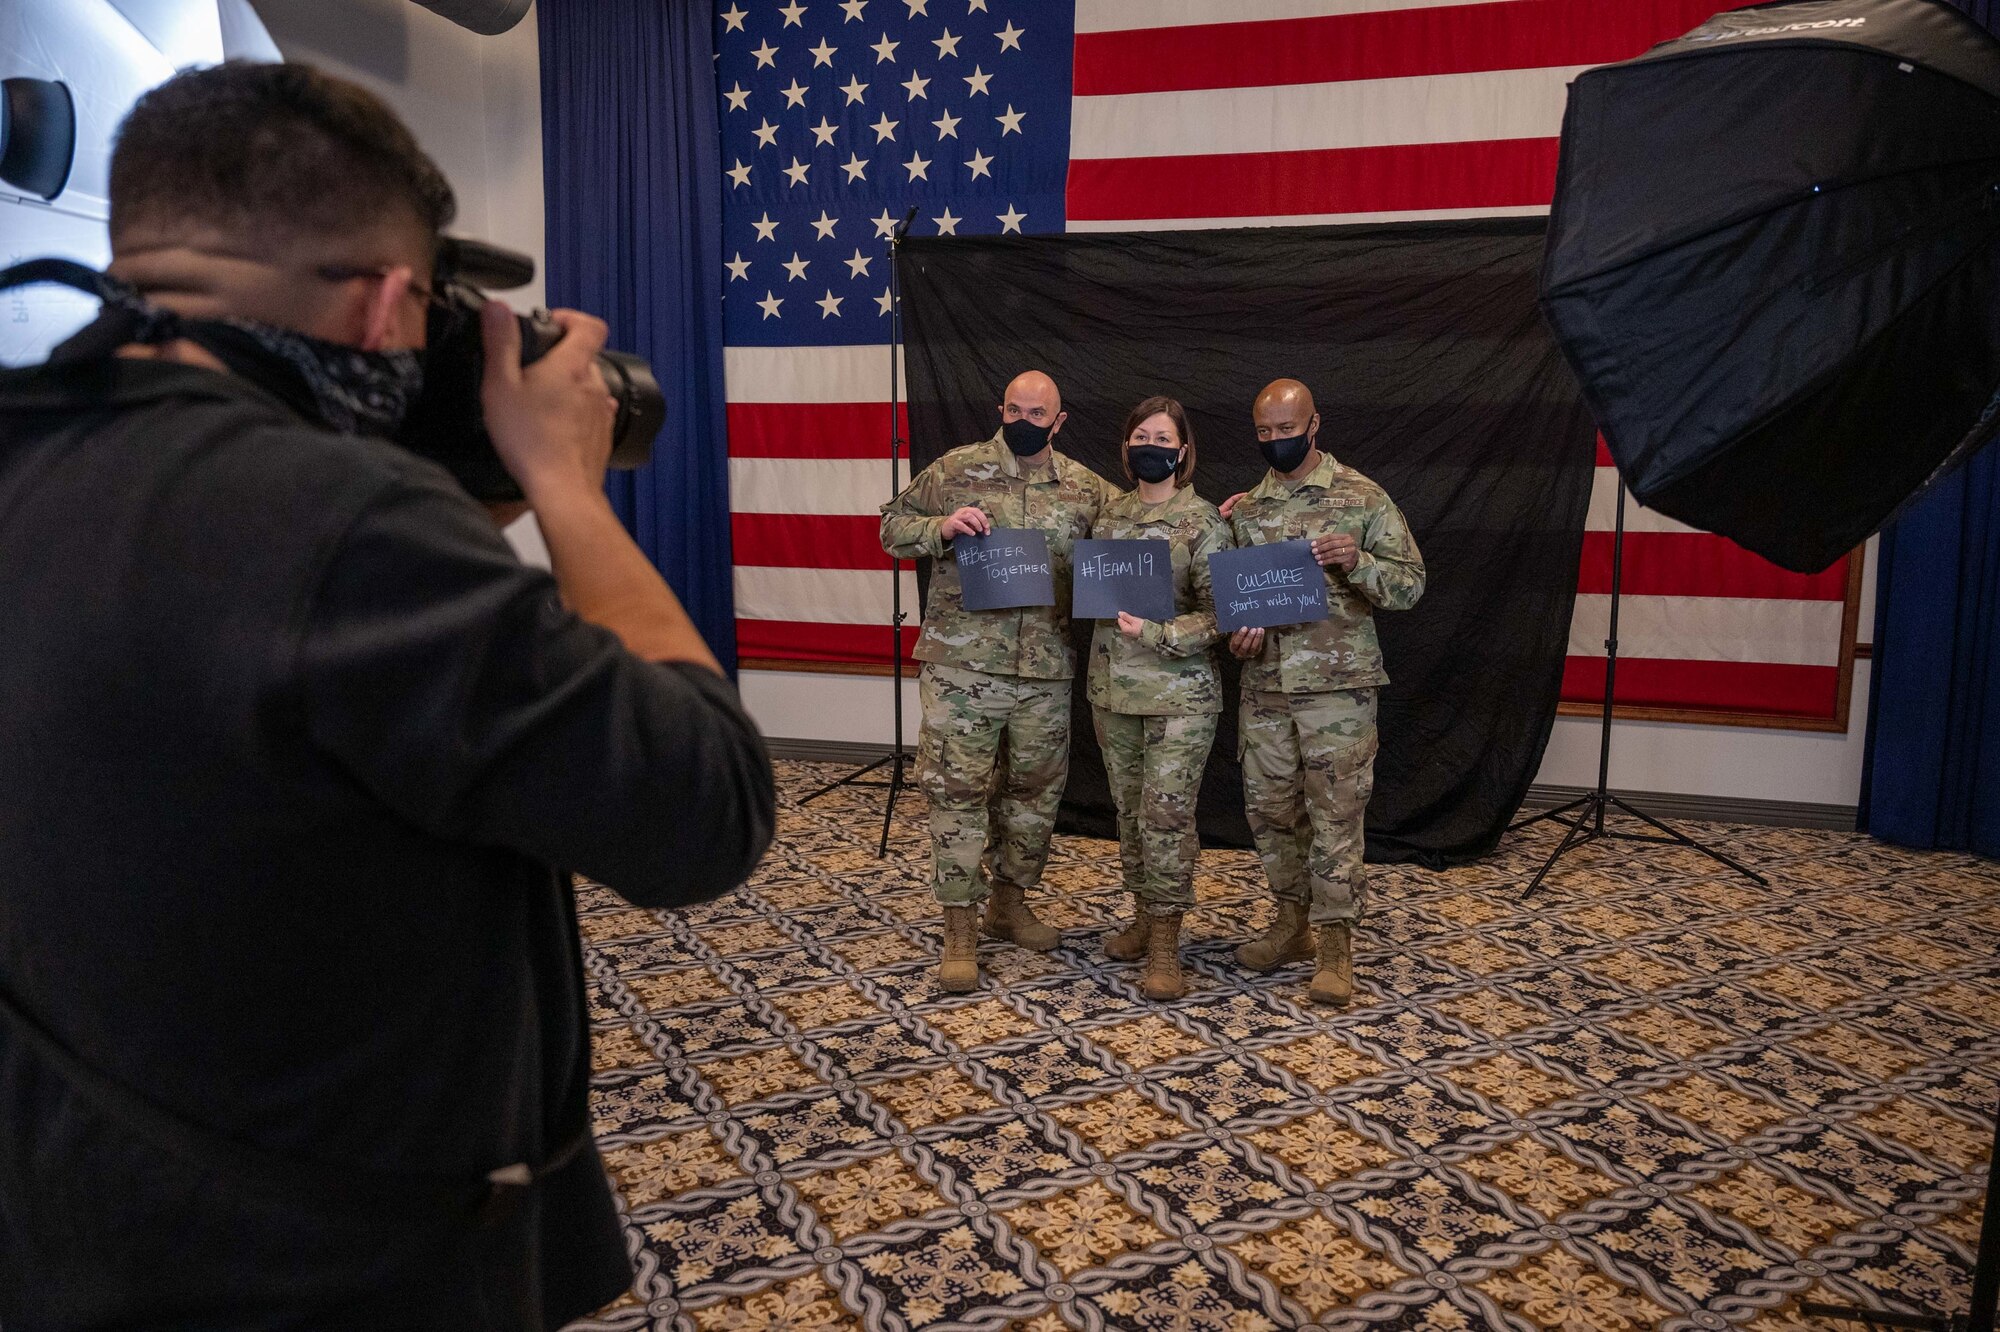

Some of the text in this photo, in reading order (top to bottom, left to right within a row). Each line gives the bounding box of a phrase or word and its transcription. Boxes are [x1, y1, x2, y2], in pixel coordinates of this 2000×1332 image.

[1081, 552, 1153, 581] #TEAM 19
[1236, 567, 1304, 591] CULTURE
[1229, 588, 1321, 617] starts with you!
